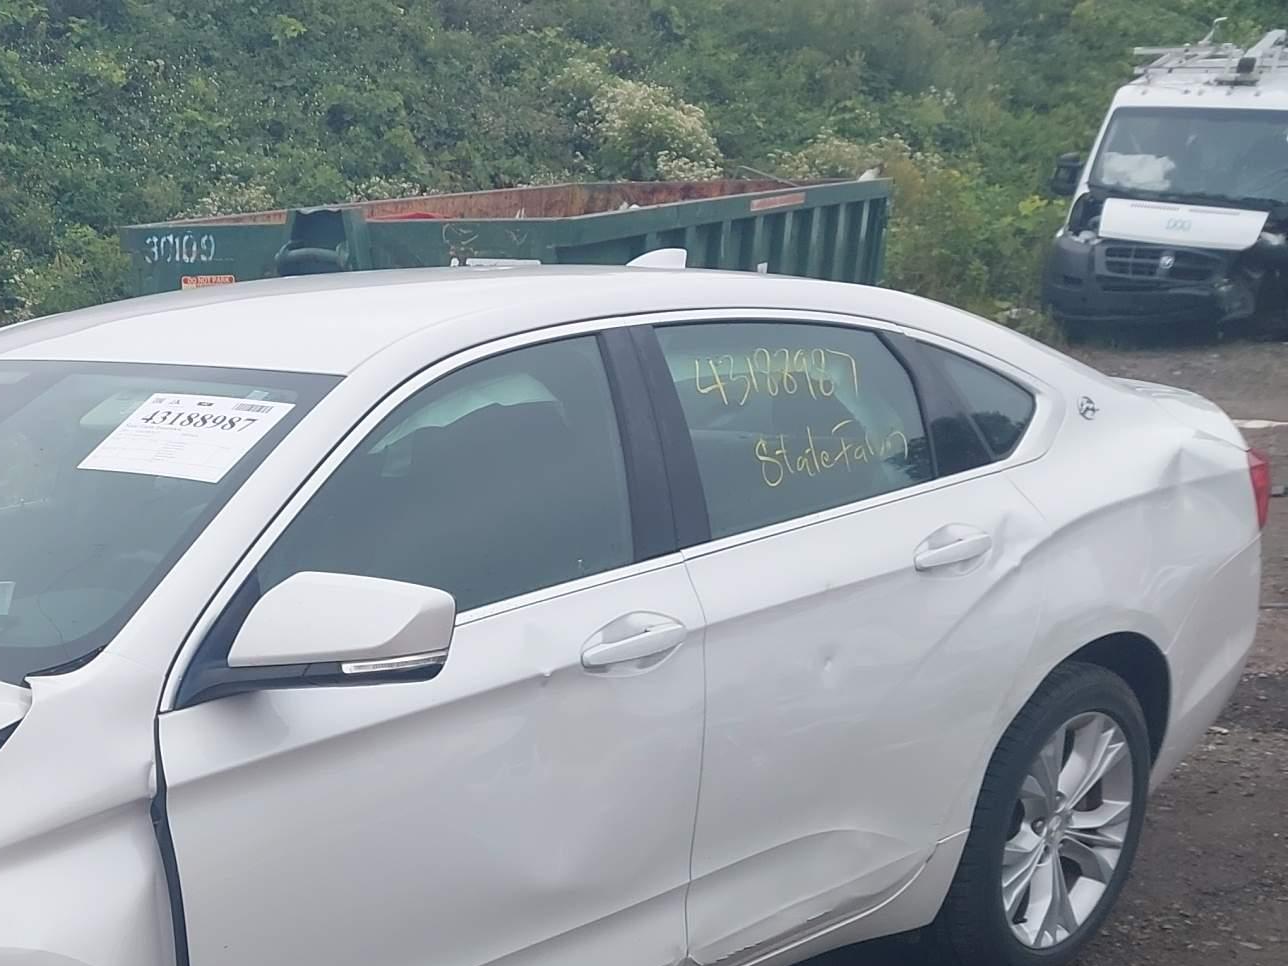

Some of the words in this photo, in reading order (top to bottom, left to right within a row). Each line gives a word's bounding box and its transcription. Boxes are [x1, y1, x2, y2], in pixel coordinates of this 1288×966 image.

[198, 276, 212, 284] NOT
[212, 275, 231, 283] PARK
[695, 347, 859, 406] 43188987
[141, 409, 259, 433] 43188987
